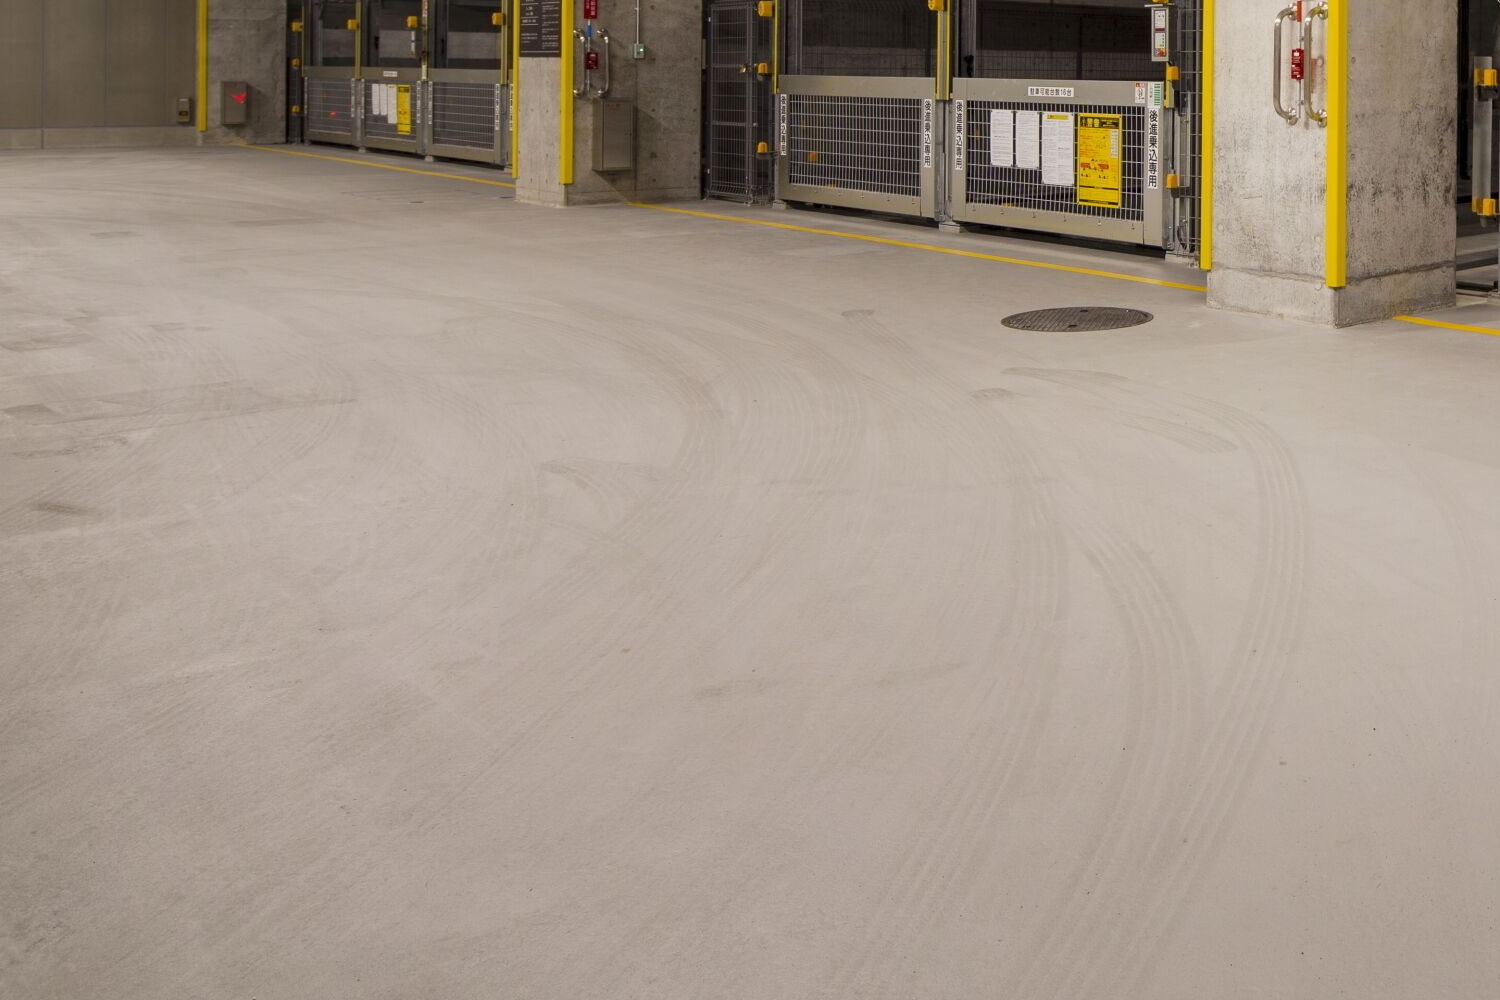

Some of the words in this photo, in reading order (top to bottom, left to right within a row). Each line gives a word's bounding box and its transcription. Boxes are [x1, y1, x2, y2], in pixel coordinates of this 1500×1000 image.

[1148, 109, 1158, 188] 後進乗込専用
